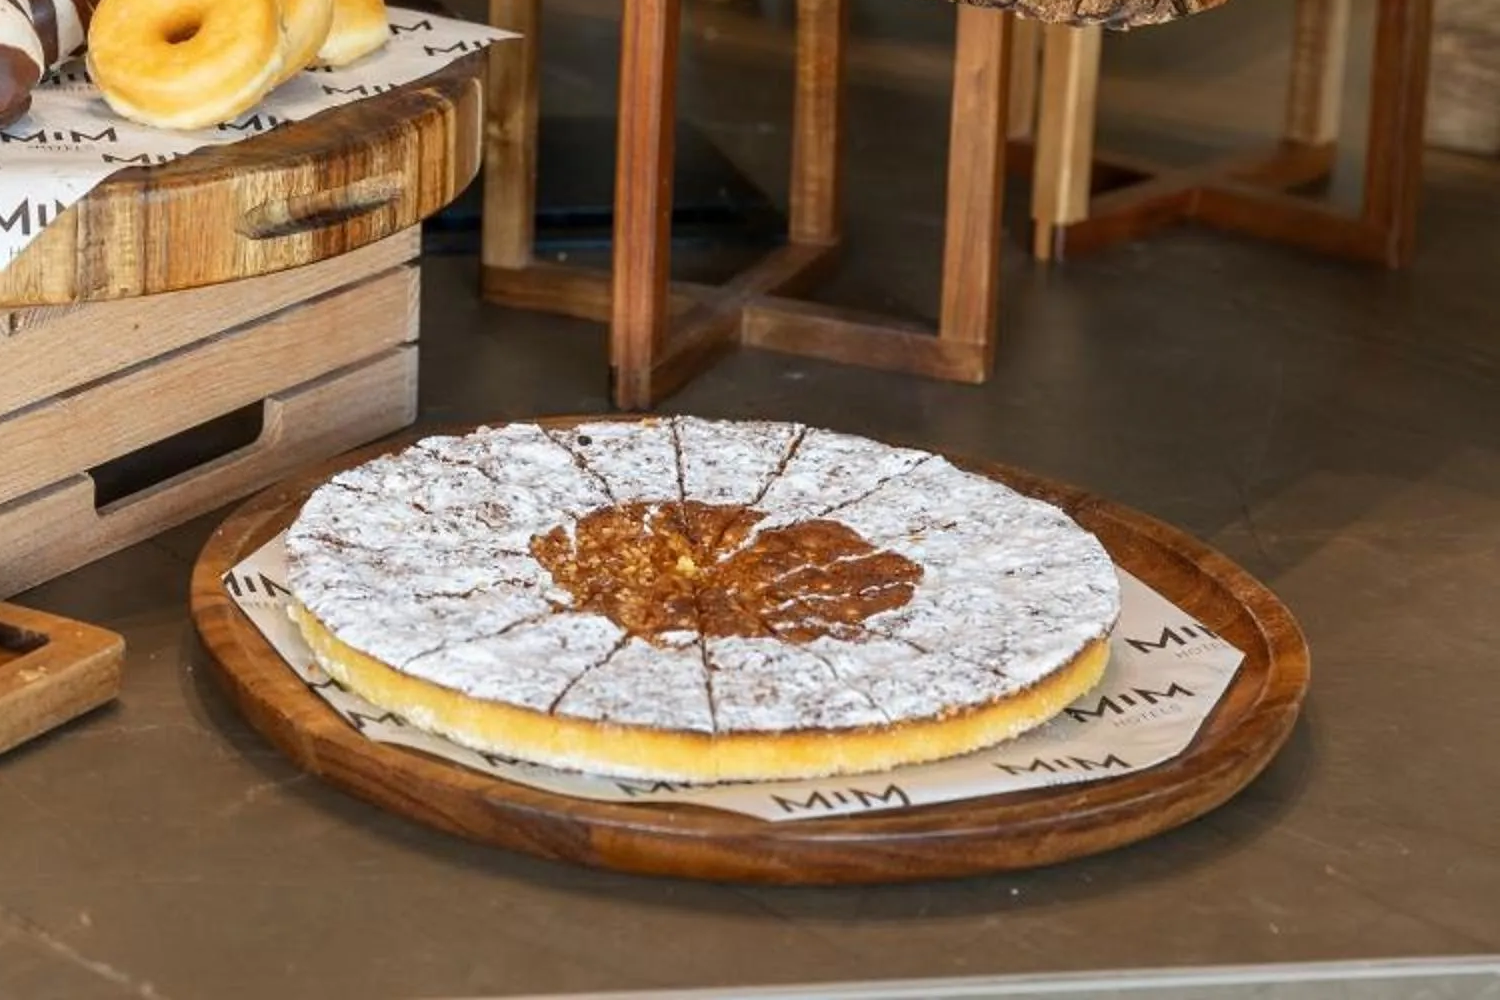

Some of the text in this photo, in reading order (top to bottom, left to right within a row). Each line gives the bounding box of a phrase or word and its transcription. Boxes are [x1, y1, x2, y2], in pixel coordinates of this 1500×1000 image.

[423, 40, 496, 56] MI
[322, 84, 397, 95] MI
[217, 114, 277, 131] MI
[103, 153, 188, 164] MI
[1124, 623, 1218, 654] MI
[1063, 682, 1196, 724] MIM
[993, 753, 1132, 776] MIM
[770, 783, 913, 814] MIM
